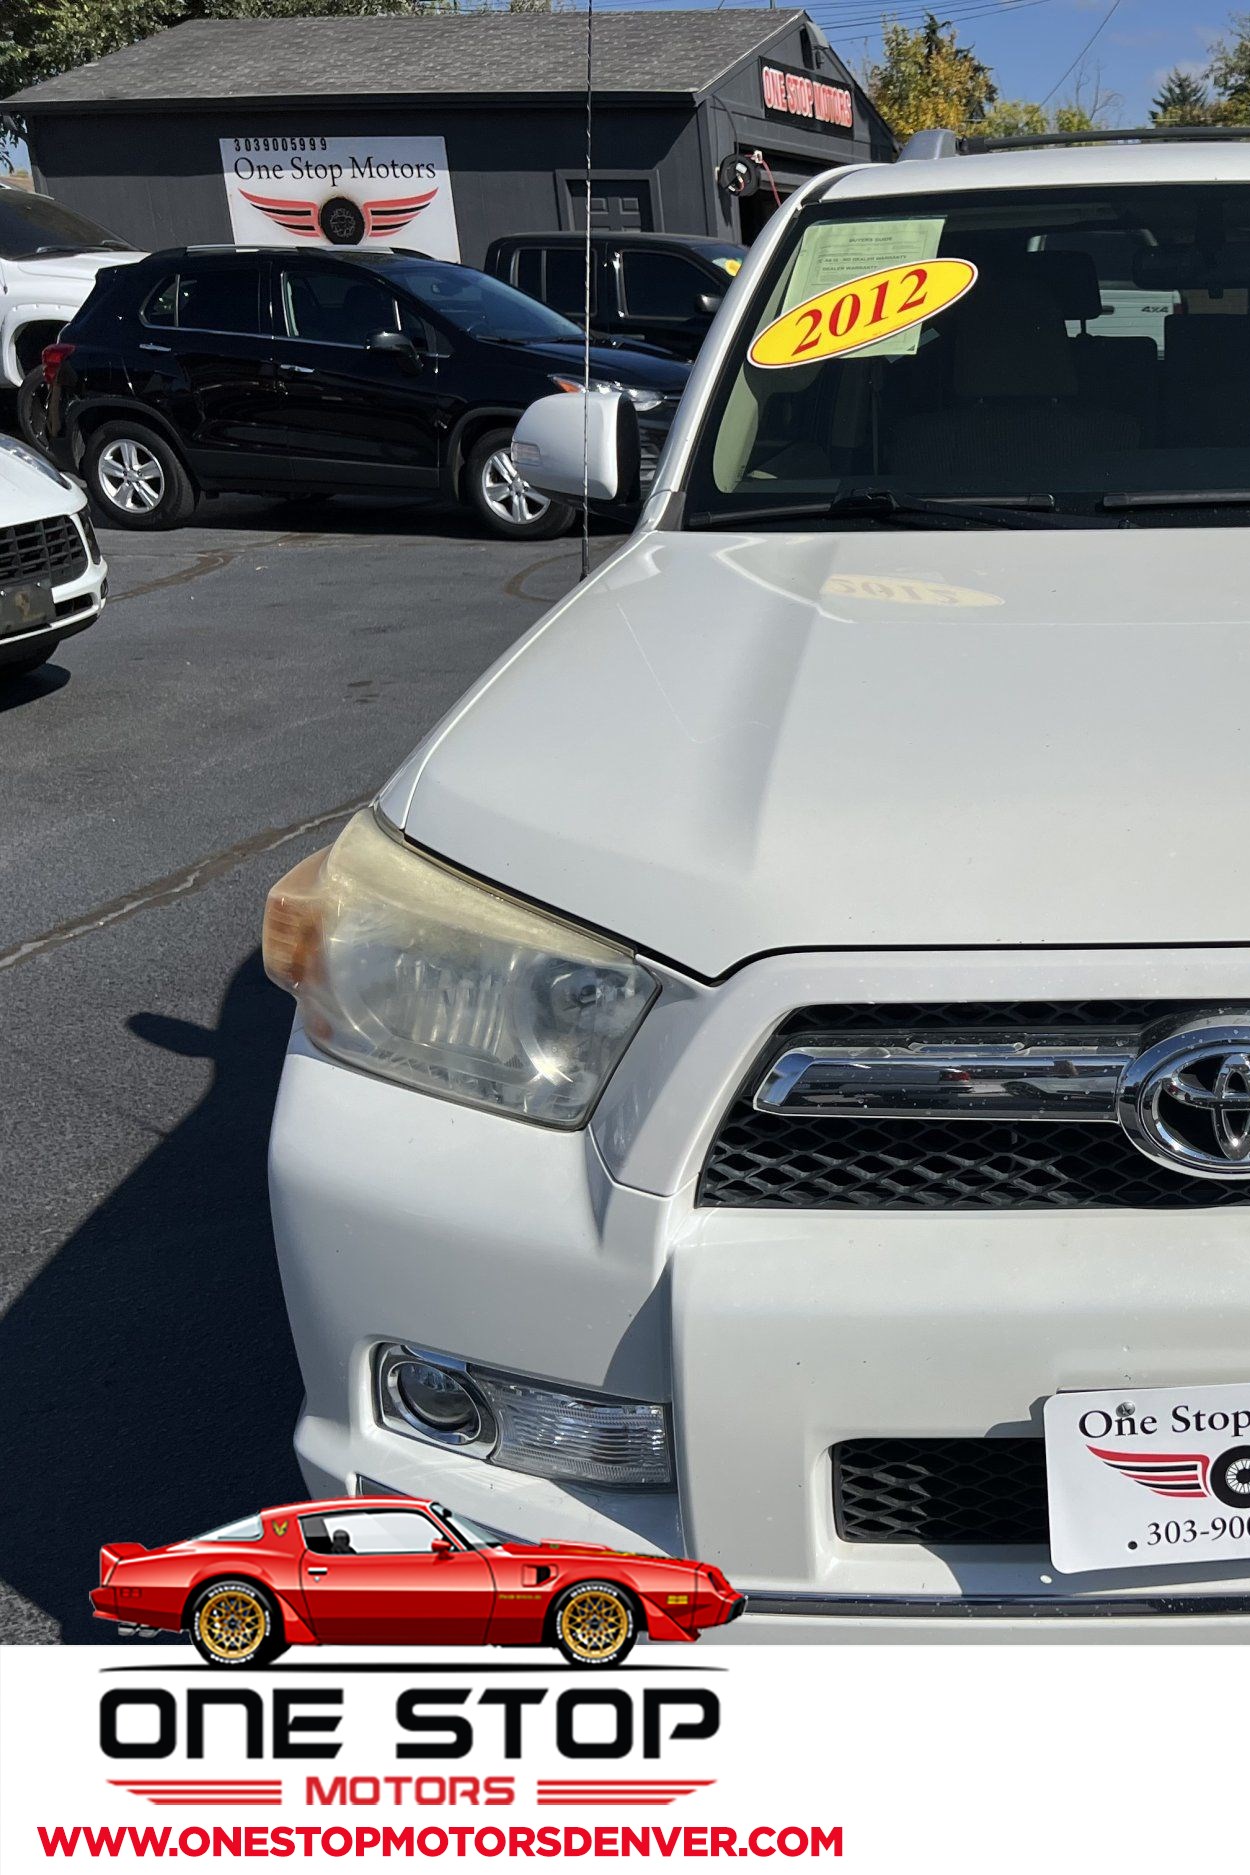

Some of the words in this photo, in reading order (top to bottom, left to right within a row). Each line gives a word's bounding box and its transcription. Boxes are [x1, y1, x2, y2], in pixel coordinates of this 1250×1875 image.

[762, 66, 788, 112] ONE
[785, 73, 814, 118] STOP
[812, 81, 853, 128] MOTORS
[234, 137, 328, 151] 3039005999
[234, 157, 284, 180] One
[290, 156, 343, 187] Stop
[349, 156, 437, 179] Motors
[791, 268, 928, 356] 2012
[1078, 1409, 1158, 1439] One
